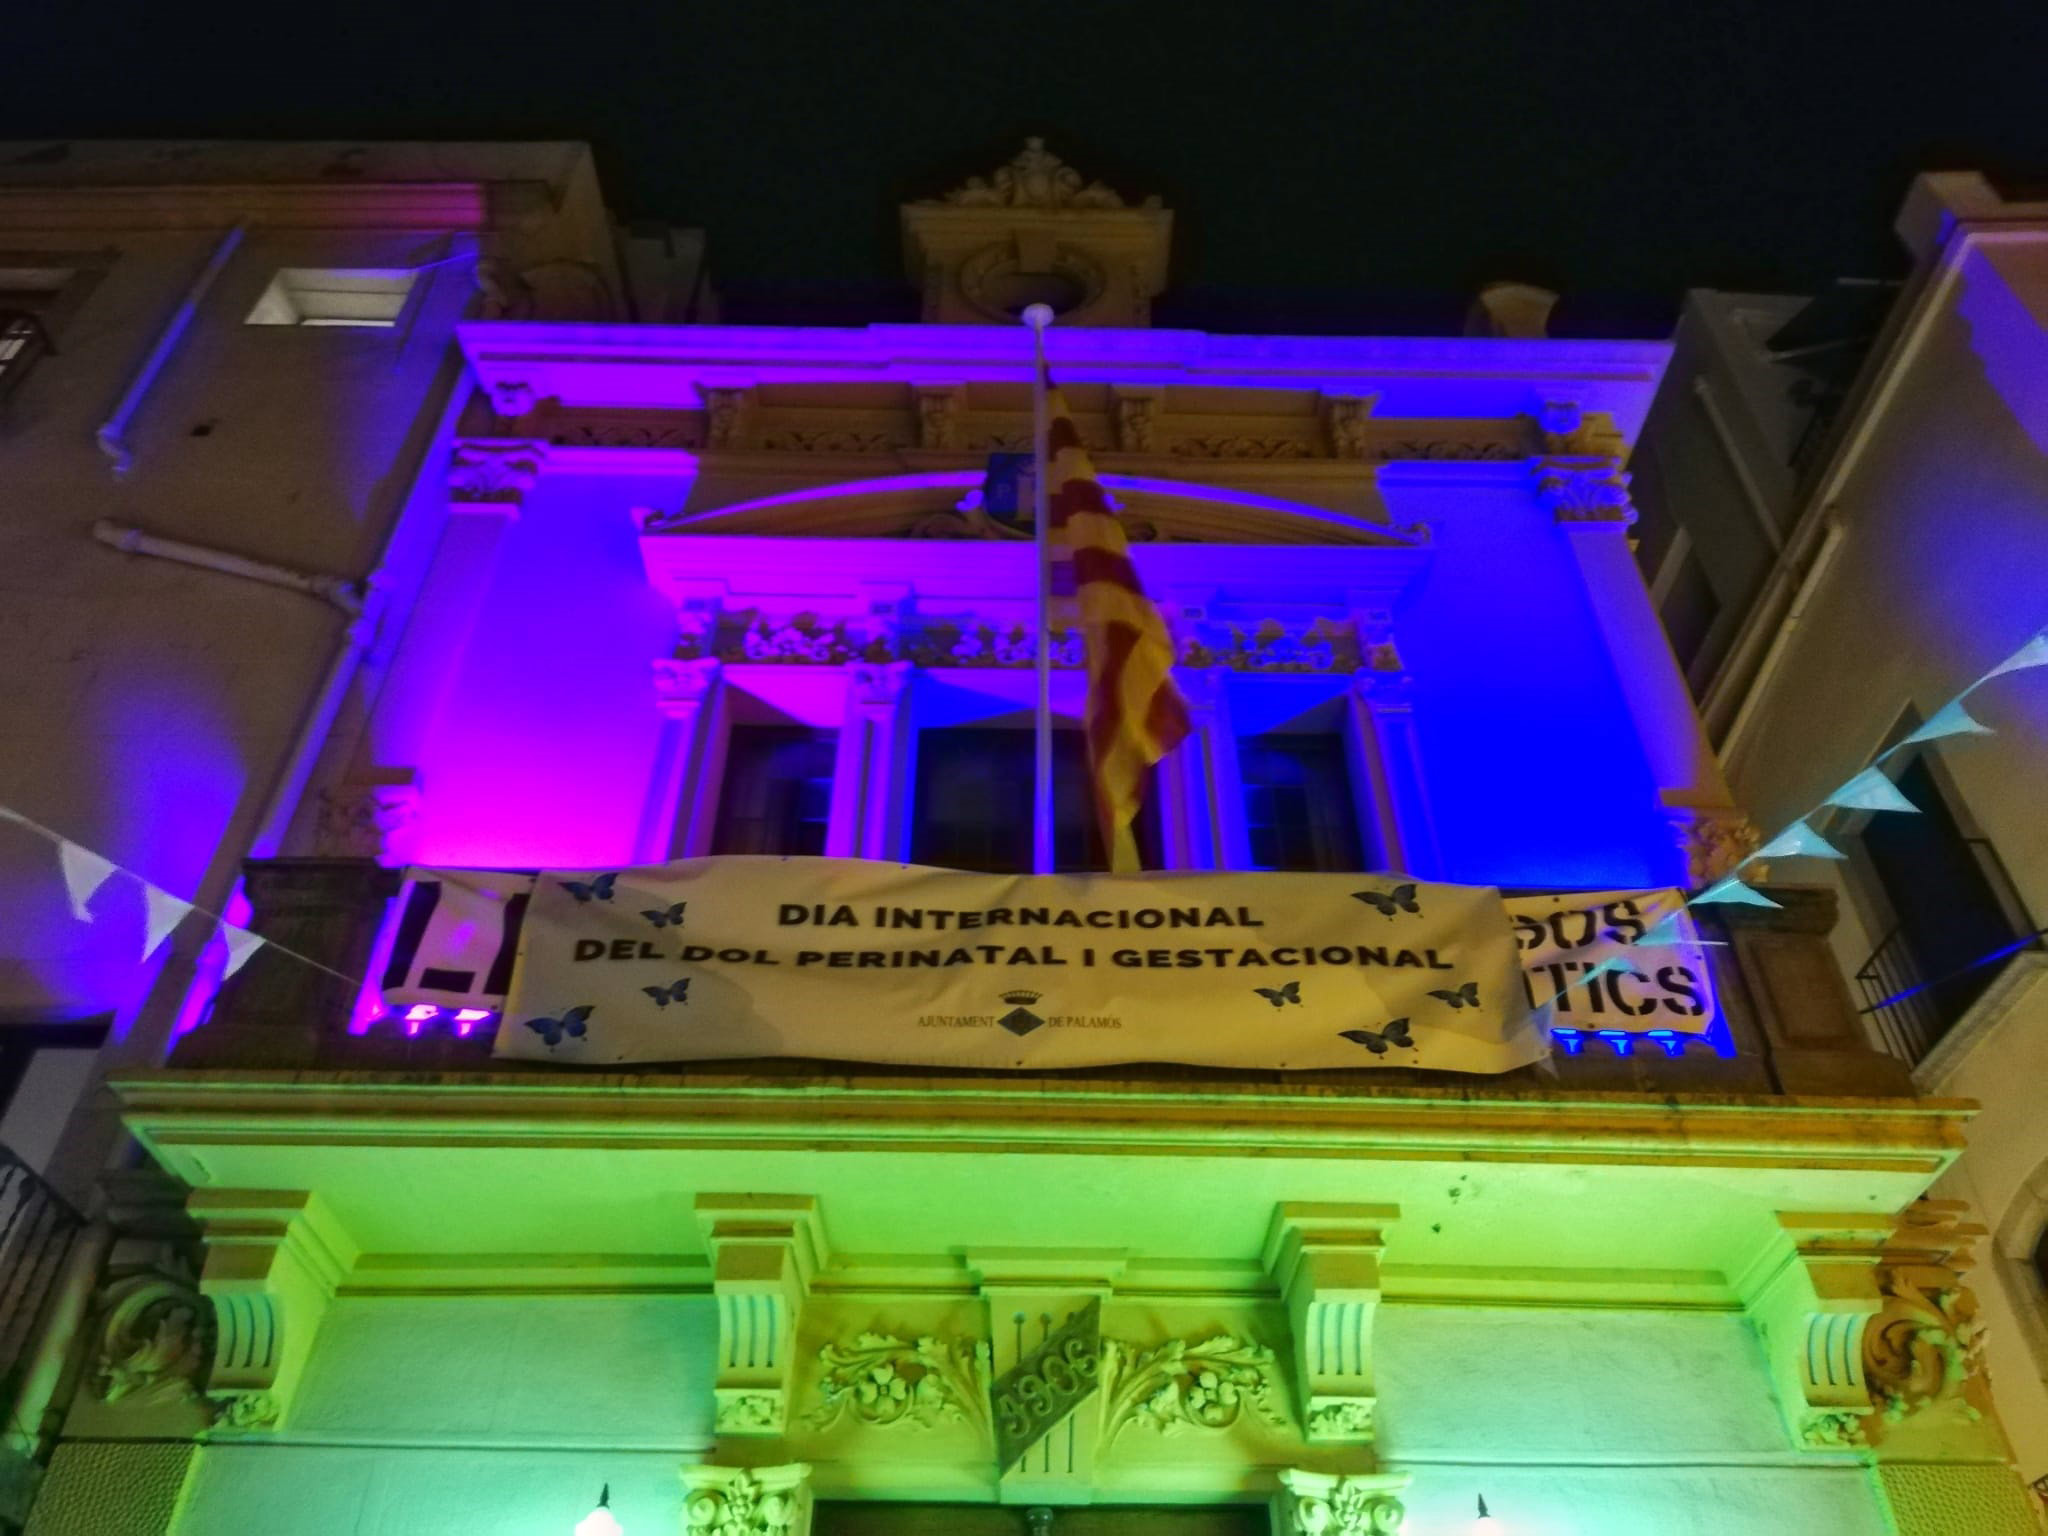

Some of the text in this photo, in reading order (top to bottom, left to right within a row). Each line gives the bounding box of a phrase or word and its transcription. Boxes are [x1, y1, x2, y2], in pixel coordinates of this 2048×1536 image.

[778, 903, 1265, 930] DIA INTERNACIONAL
[573, 939, 1454, 969] DEL DOL PERINATAL I GESTACIONAL
[917, 1013, 1123, 1030] AJUNTAMENT DE PALAMÓS
